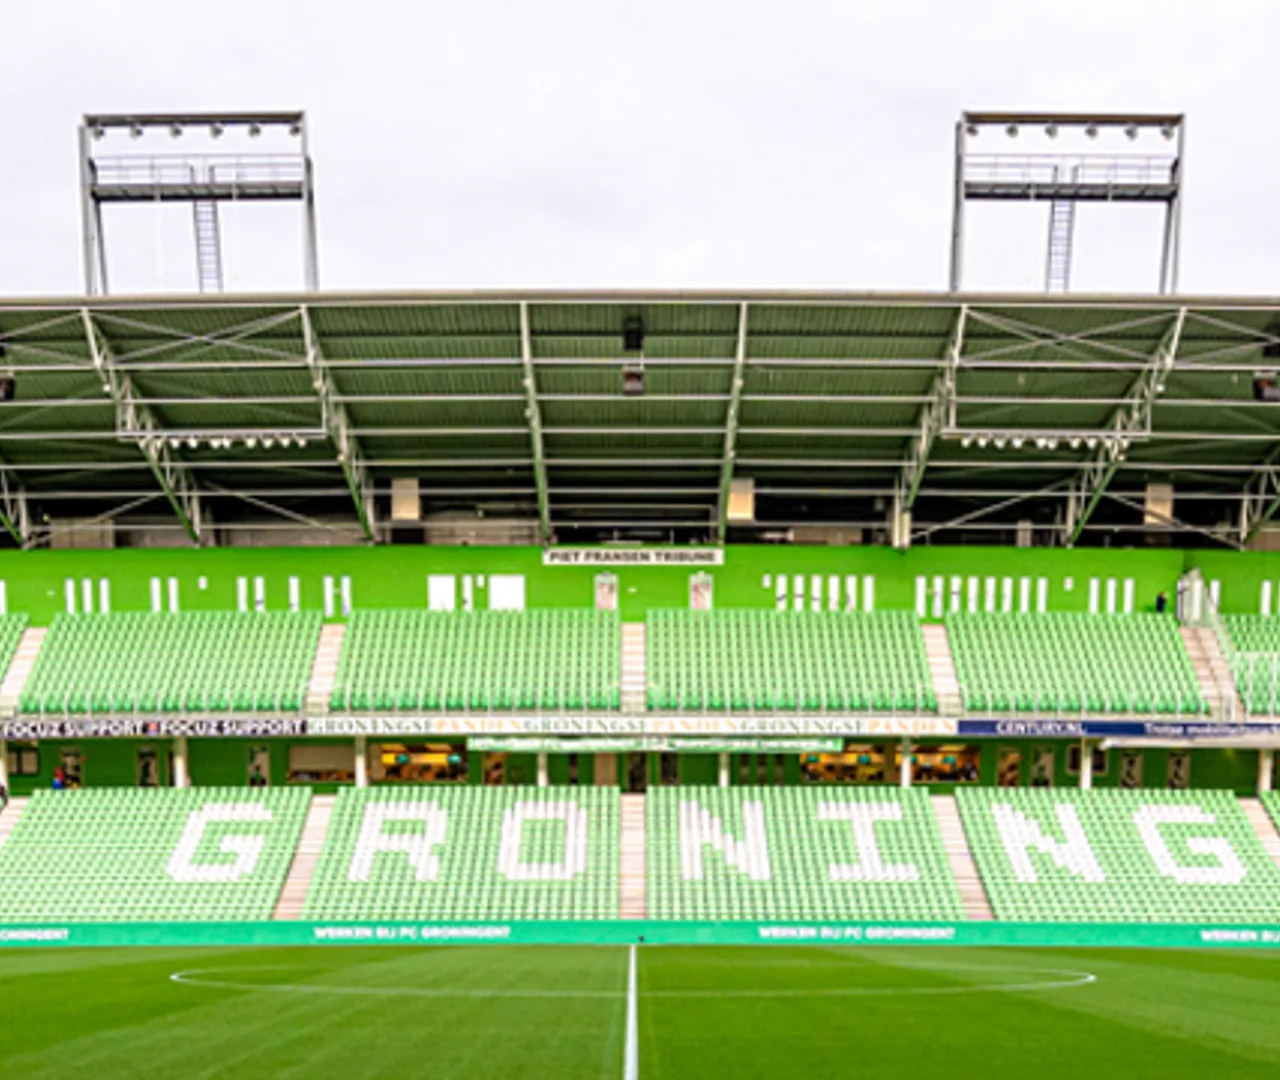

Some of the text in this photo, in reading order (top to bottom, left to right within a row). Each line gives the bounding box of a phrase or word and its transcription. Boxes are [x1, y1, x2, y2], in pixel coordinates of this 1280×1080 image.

[549, 551, 716, 562] PIET FRANSEN TRIBUNE
